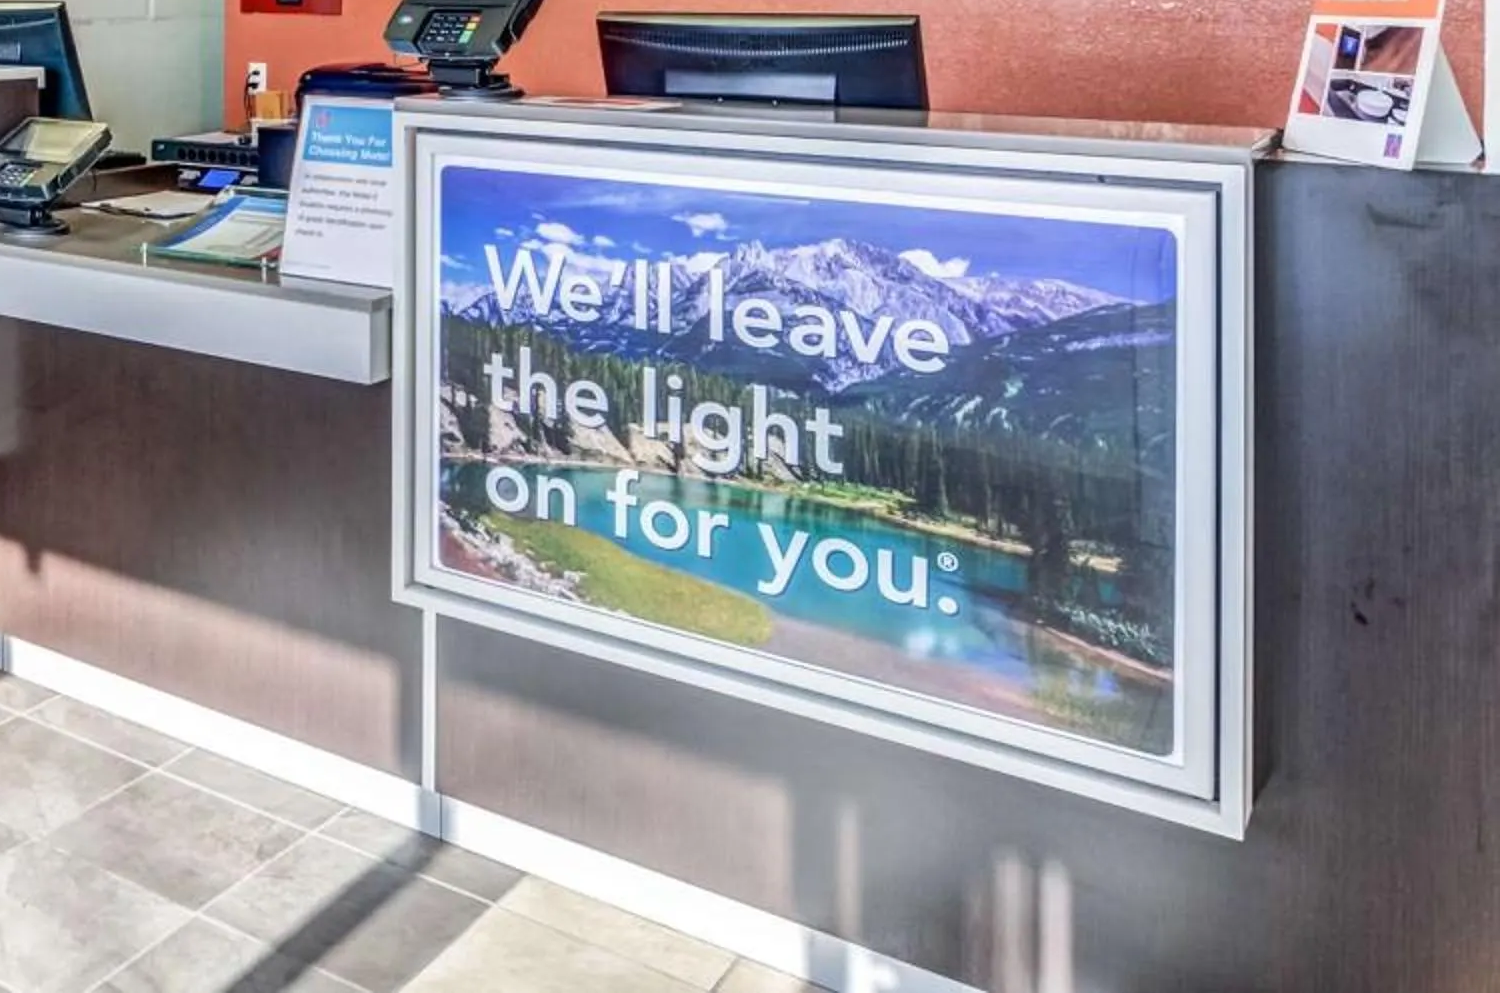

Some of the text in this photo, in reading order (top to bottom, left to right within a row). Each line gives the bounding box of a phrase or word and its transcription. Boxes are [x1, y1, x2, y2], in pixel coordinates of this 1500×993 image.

[311, 131, 387, 147] Thank You For
[484, 244, 950, 374] We'll leave
[483, 347, 844, 476] the light
[484, 467, 577, 527] on
[606, 469, 730, 558] for
